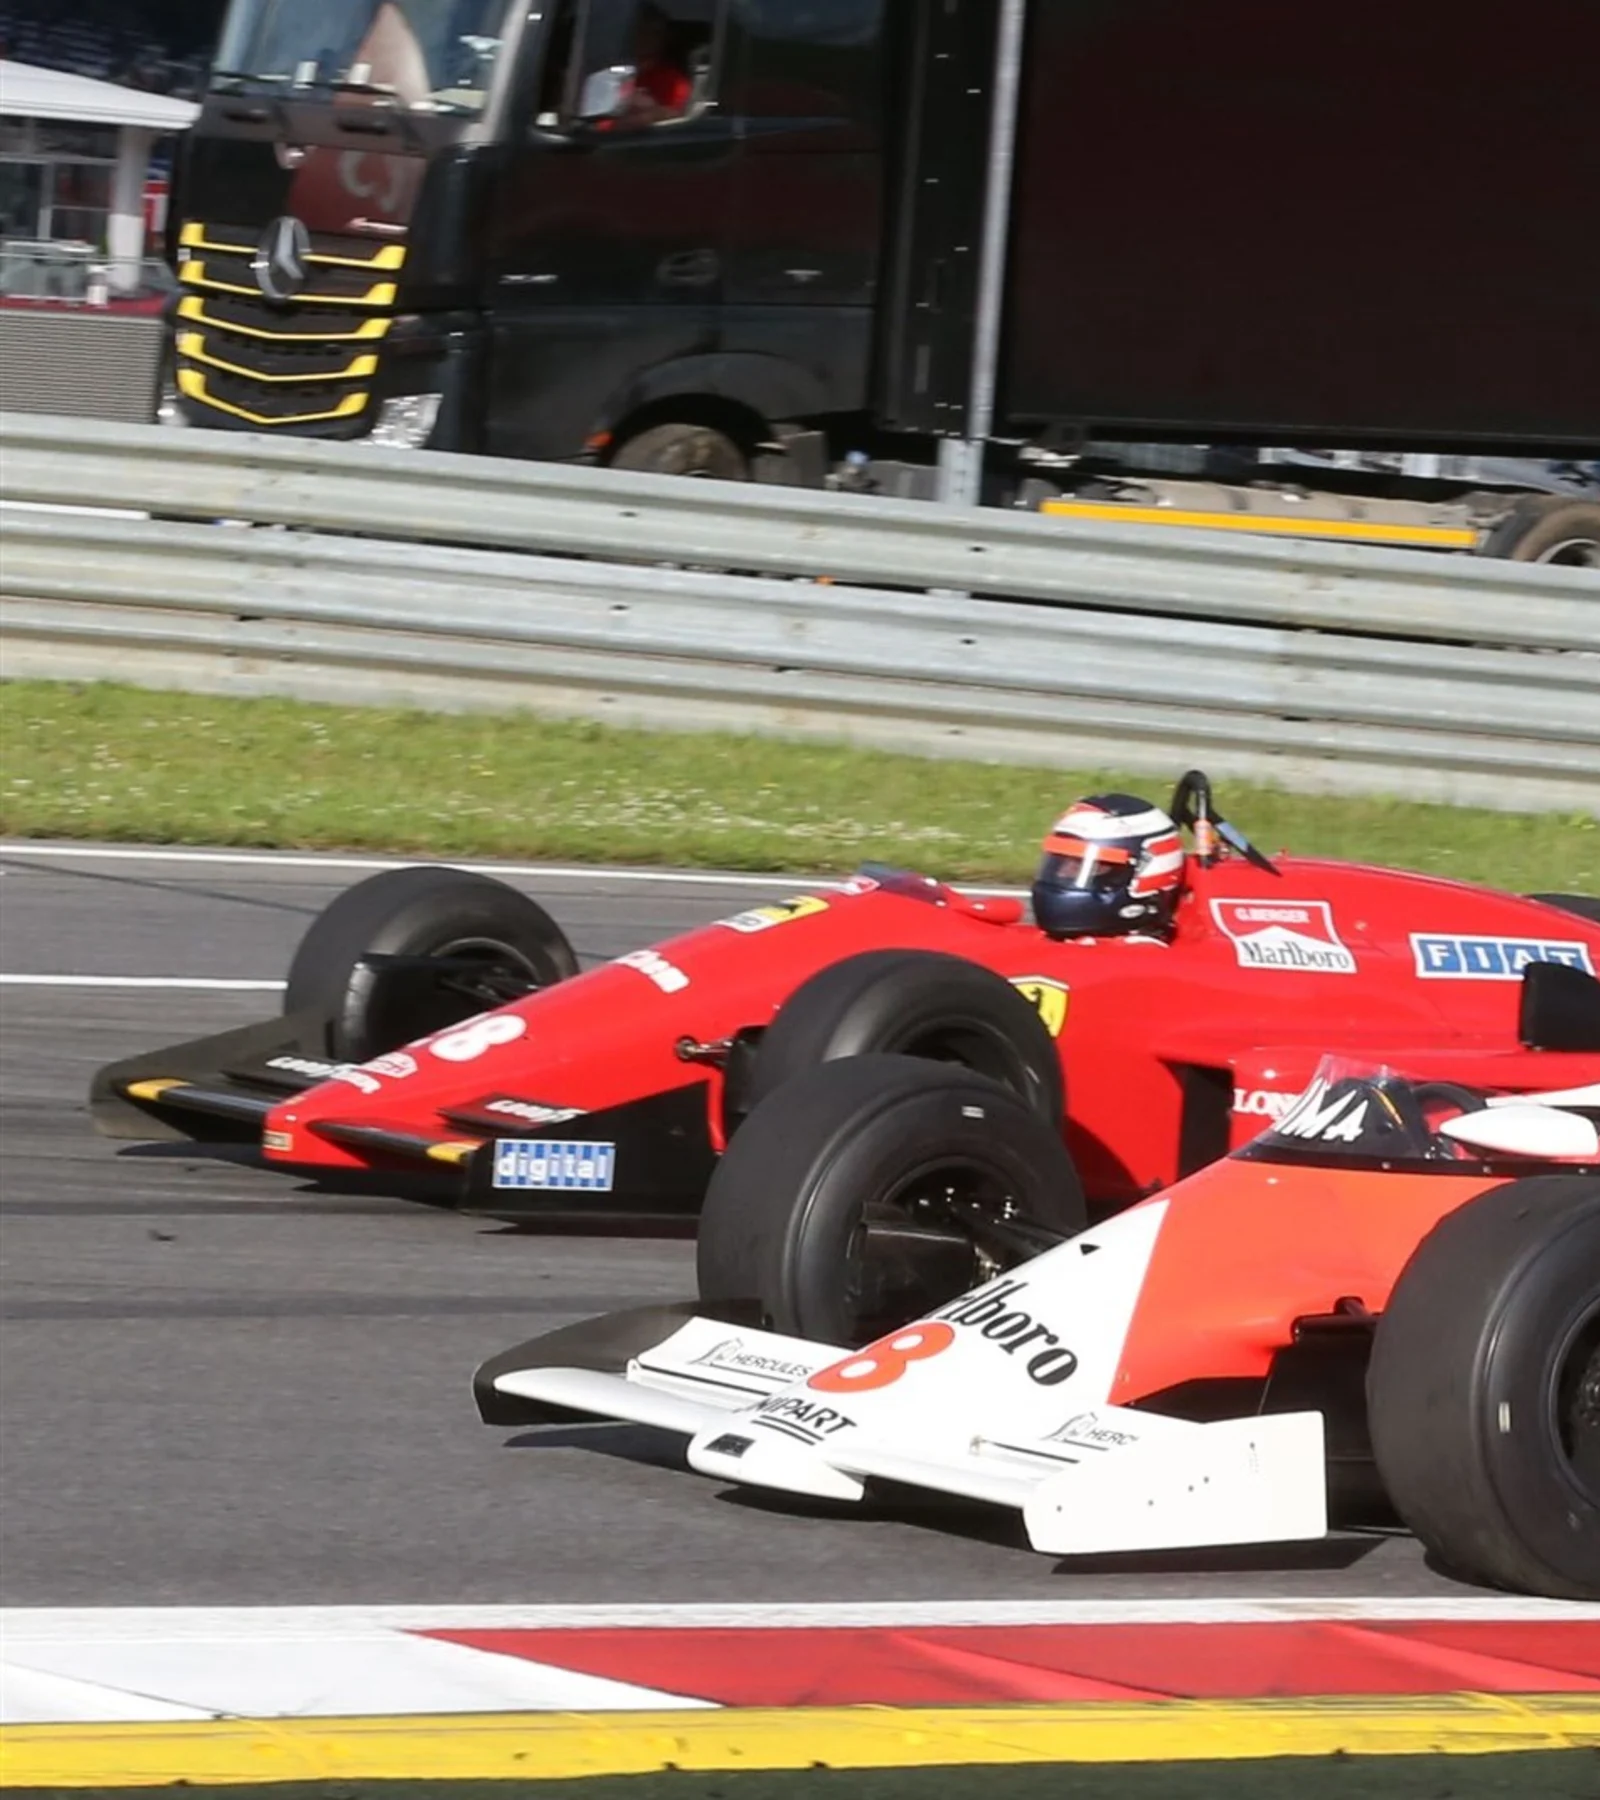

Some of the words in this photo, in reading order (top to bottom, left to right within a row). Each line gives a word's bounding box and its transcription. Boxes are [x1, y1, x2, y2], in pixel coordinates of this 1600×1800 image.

[1240, 940, 1351, 969] Marlboro
[1427, 942, 1578, 969] FIAT
[497, 1150, 608, 1181] digital
[928, 1279, 1079, 1387] rlboro
[806, 1321, 956, 1394] 8
